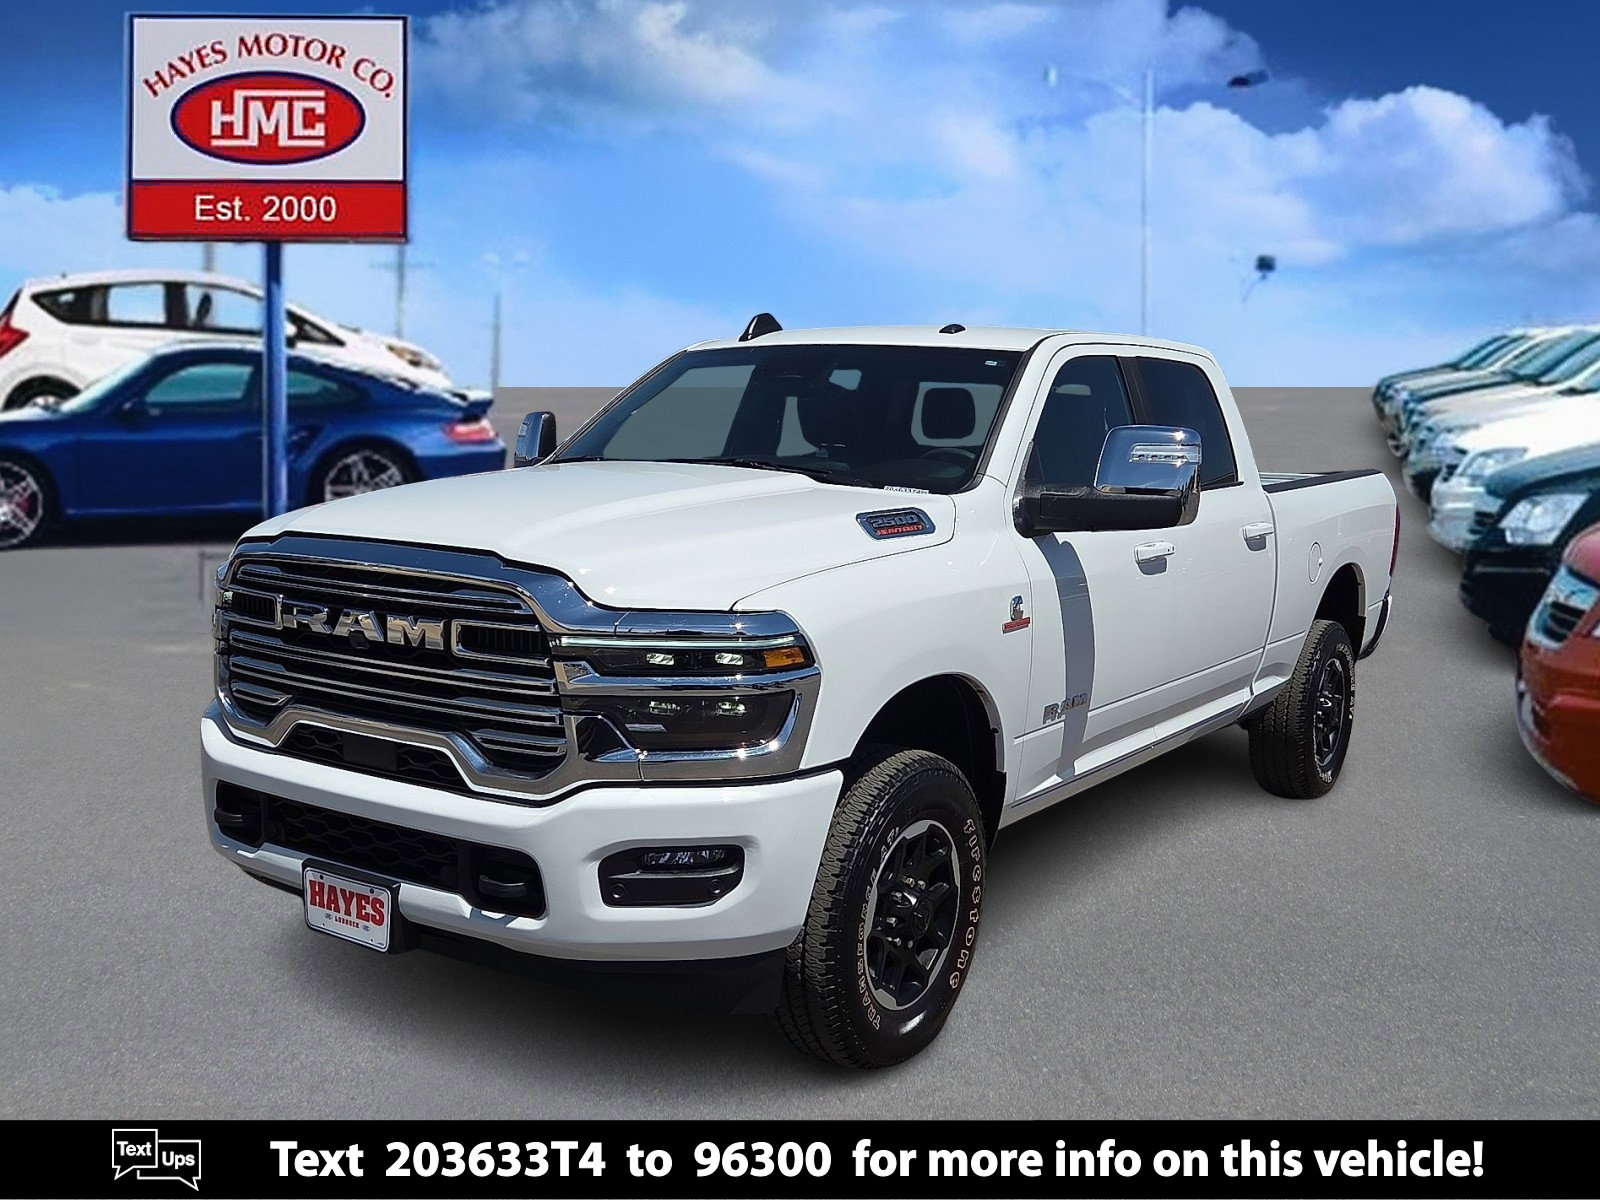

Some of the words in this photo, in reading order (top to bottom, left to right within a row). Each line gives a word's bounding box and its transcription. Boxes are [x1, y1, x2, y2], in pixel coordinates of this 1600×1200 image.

[143, 40, 228, 98] HAYES
[238, 33, 347, 69] MOTOR
[353, 57, 395, 98] CO.
[210, 88, 326, 147] HMC
[194, 195, 250, 221] Est.
[262, 195, 338, 222] 2000
[871, 513, 919, 528] 2500
[282, 600, 445, 651] RAM
[1042, 692, 1089, 725] RAM
[308, 879, 385, 927] HAYES
